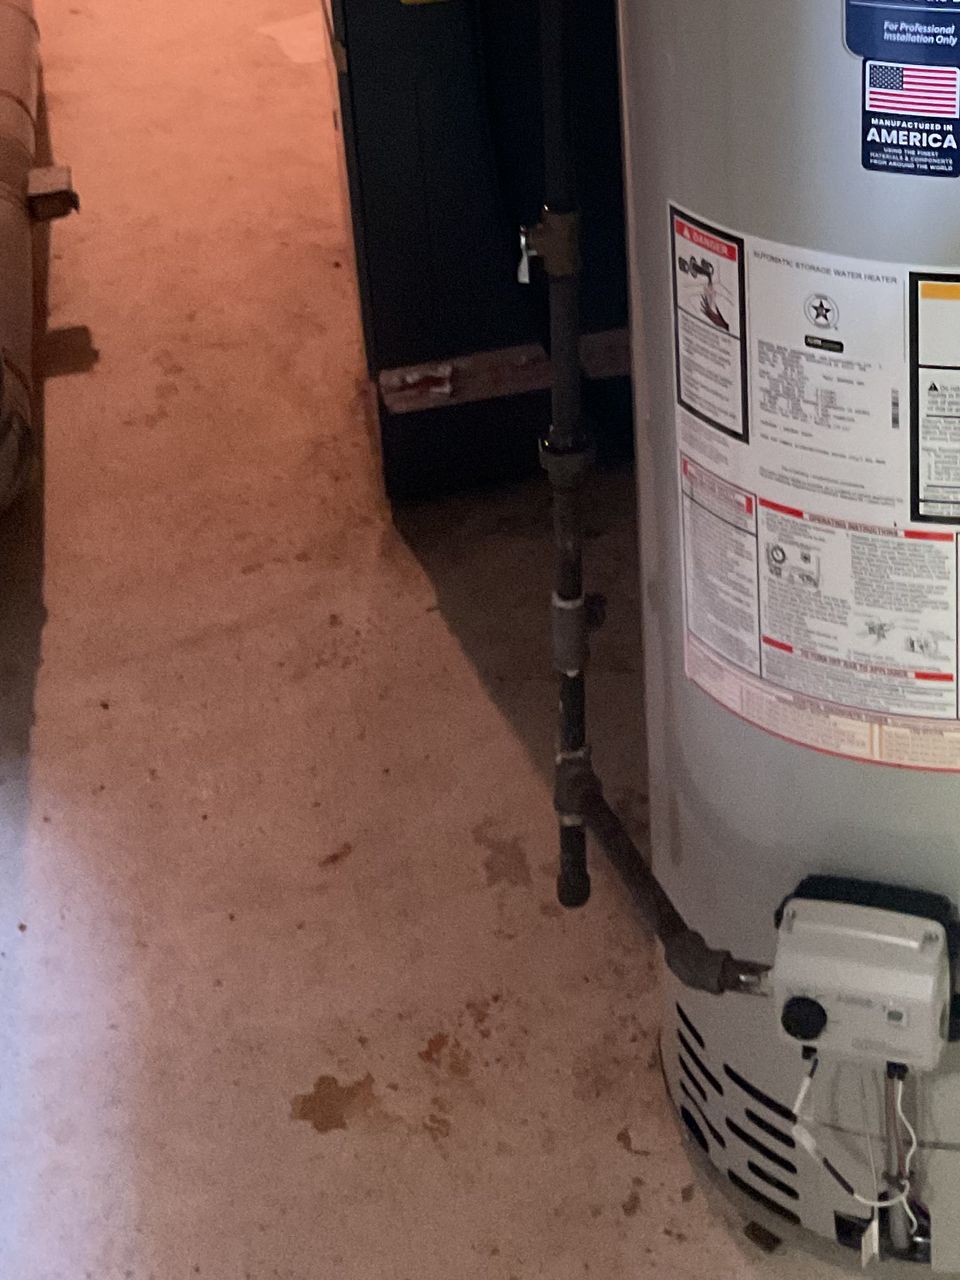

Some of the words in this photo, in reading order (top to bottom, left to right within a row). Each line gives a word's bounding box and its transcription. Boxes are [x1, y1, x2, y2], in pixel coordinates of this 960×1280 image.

[883, 21, 899, 31] For
[900, 22, 955, 34] Professional
[883, 31, 934, 44] Installation
[936, 35, 958, 47] Only
[871, 117, 941, 131] MANUFACTURED
[943, 124, 953, 132] IN
[866, 127, 958, 149] AMERICA
[795, 262, 831, 276] STORAGE
[833, 267, 862, 280] WATER
[863, 273, 898, 285] HEATER
